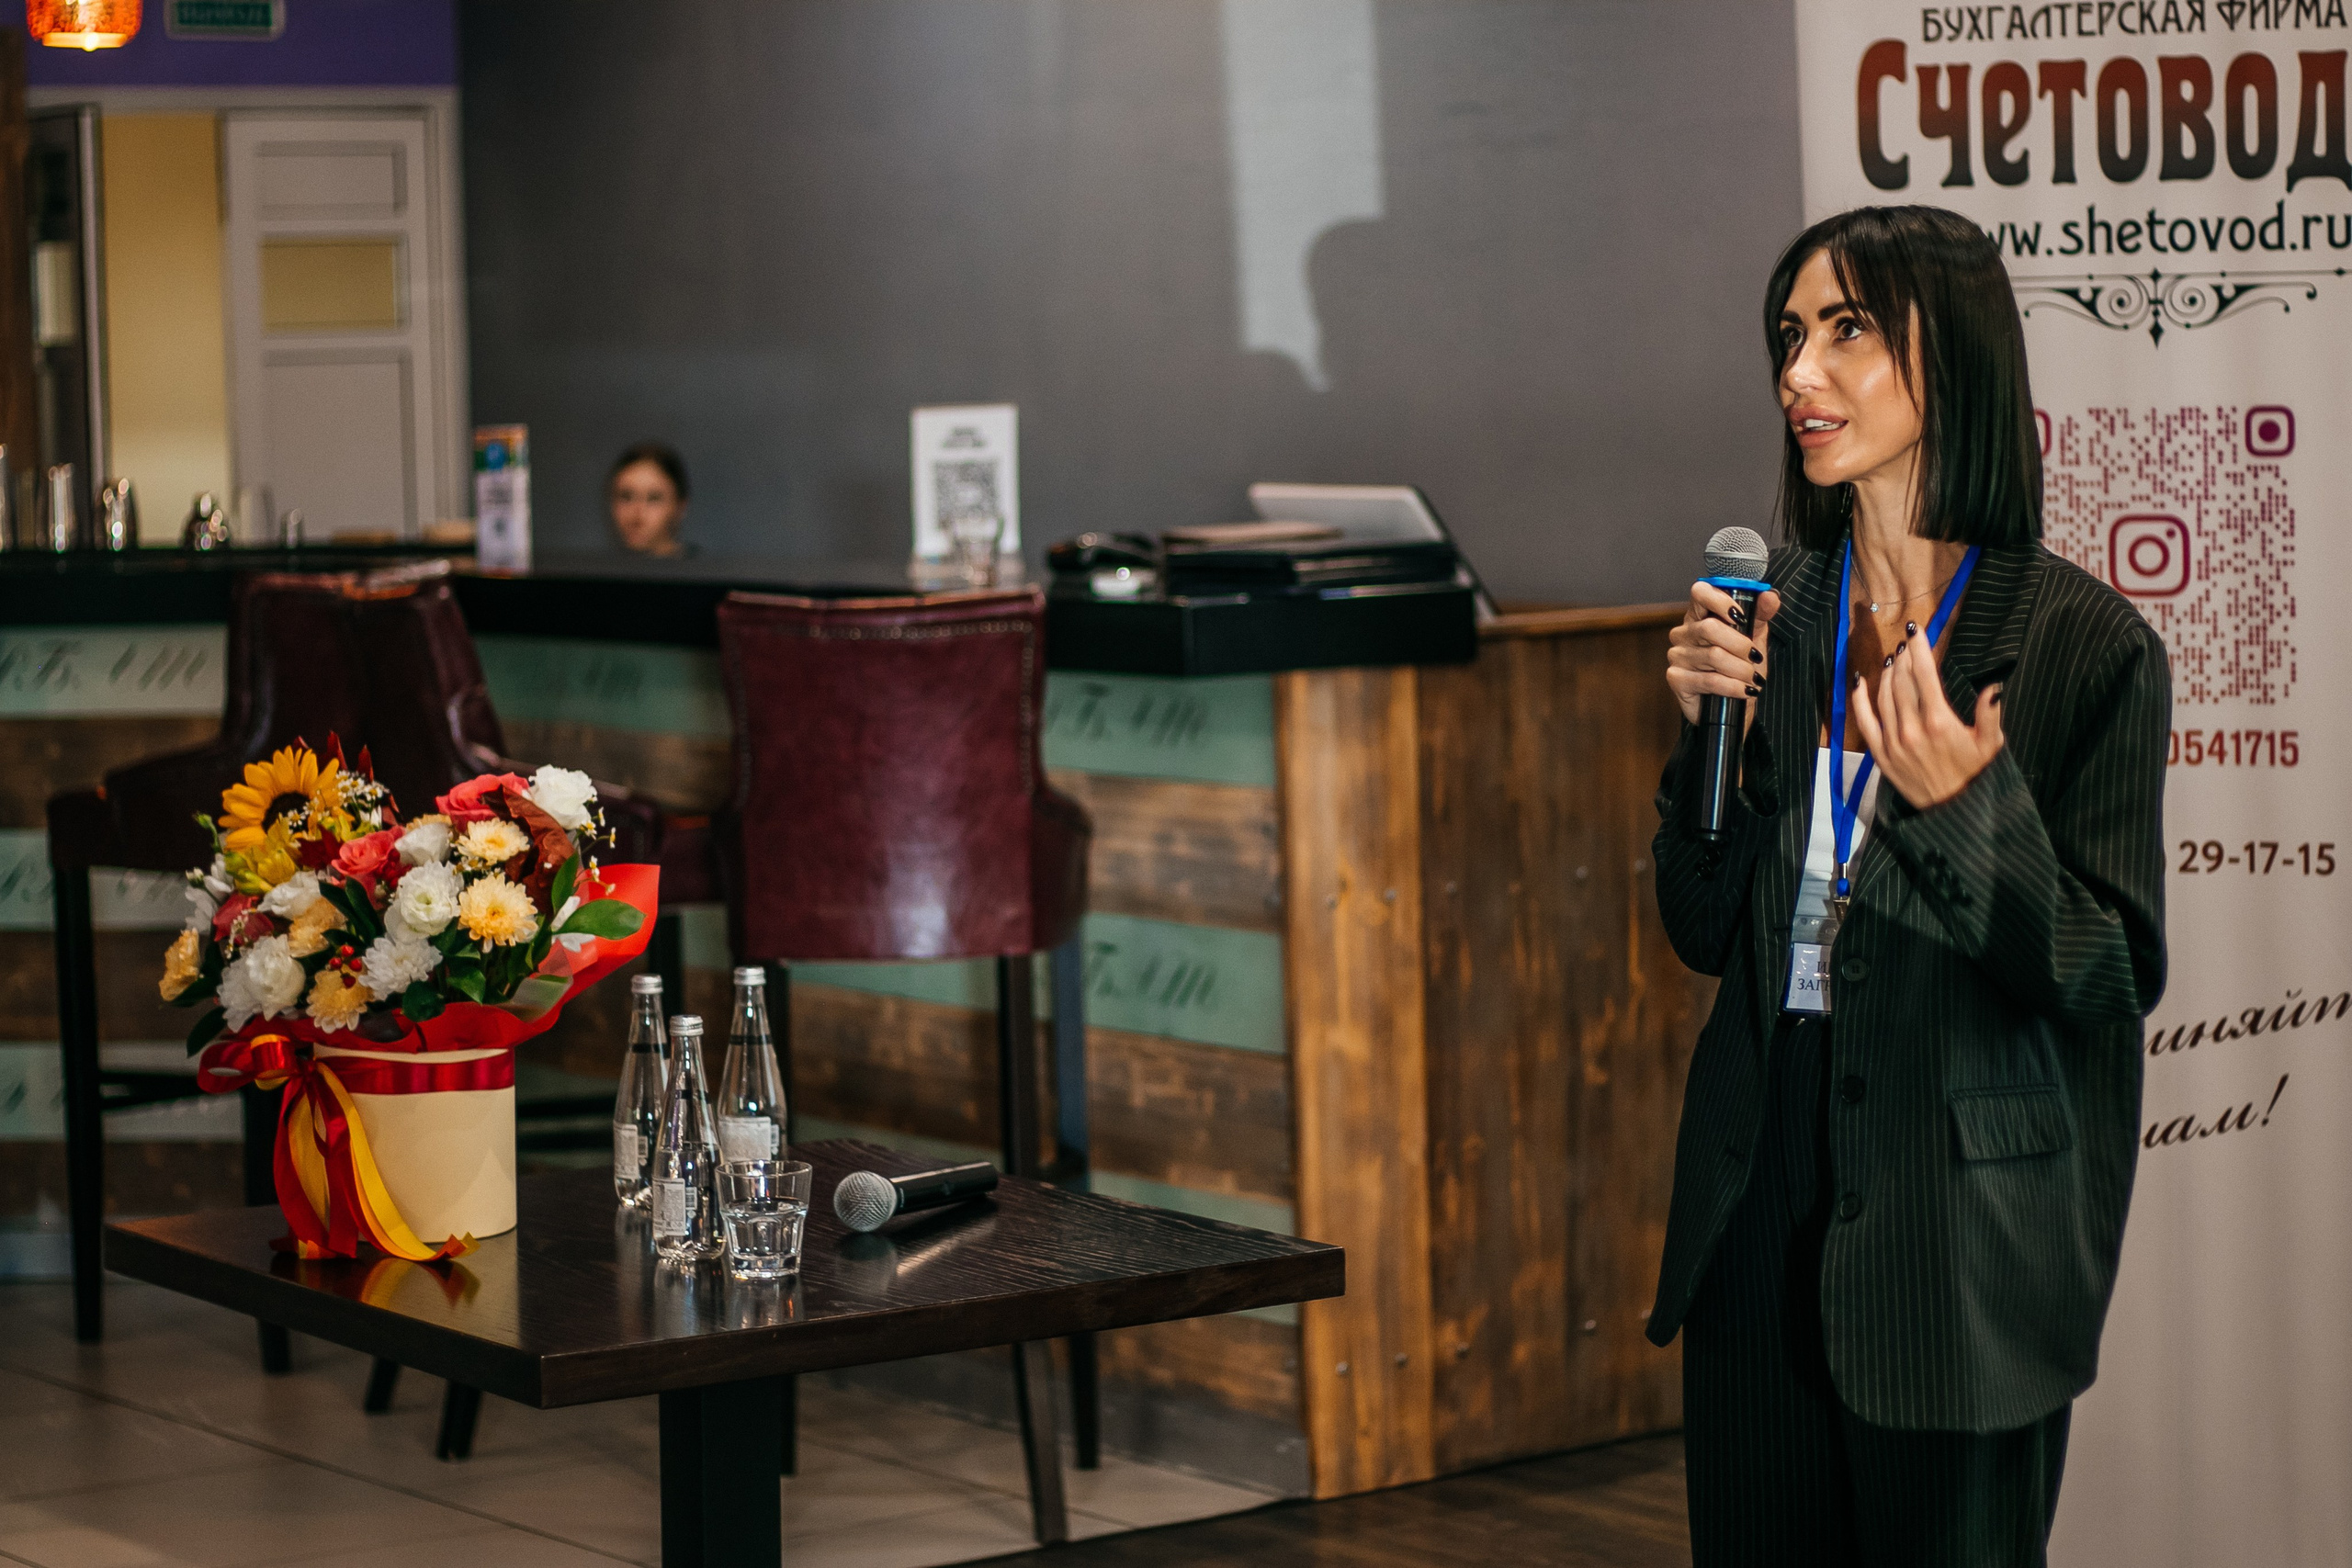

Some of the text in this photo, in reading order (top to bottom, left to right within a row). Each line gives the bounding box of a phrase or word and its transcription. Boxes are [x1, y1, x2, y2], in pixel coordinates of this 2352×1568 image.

[1922, 0, 2348, 42] БУХГАЛТЕРСКАЯ ФИРМА
[2177, 840, 2336, 876] 29-17-15
